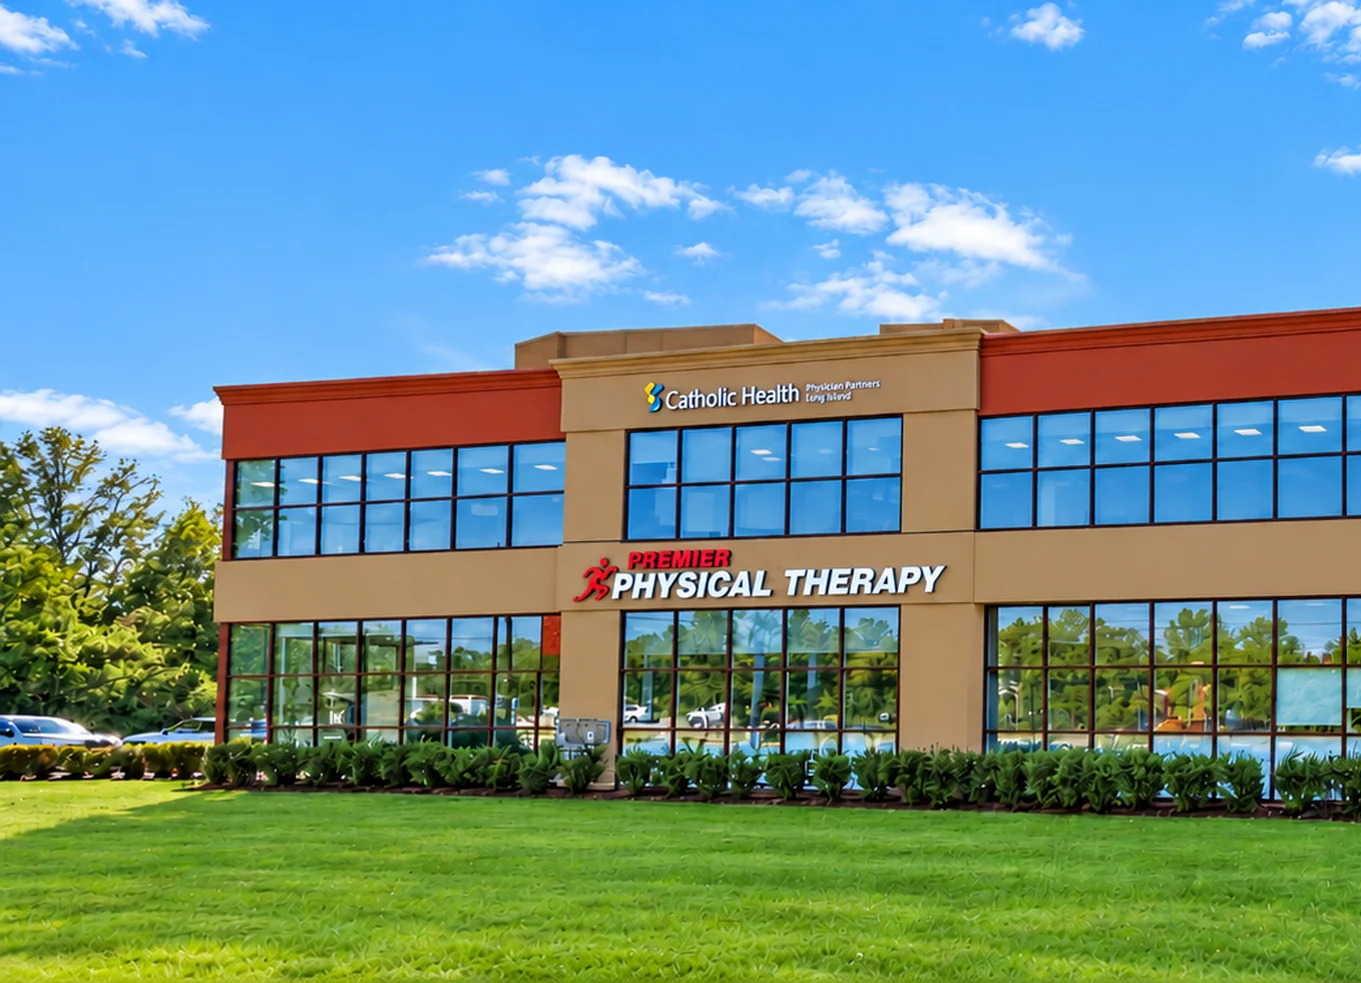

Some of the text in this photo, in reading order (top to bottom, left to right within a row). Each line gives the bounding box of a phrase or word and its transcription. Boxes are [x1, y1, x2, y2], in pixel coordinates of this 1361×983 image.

[665, 383, 800, 411] Catholic Health
[805, 380, 881, 393] Physician Partners
[827, 391, 852, 402] Island
[628, 549, 732, 570] PREMIER
[611, 564, 946, 600] PHYSICAL THERAPY
